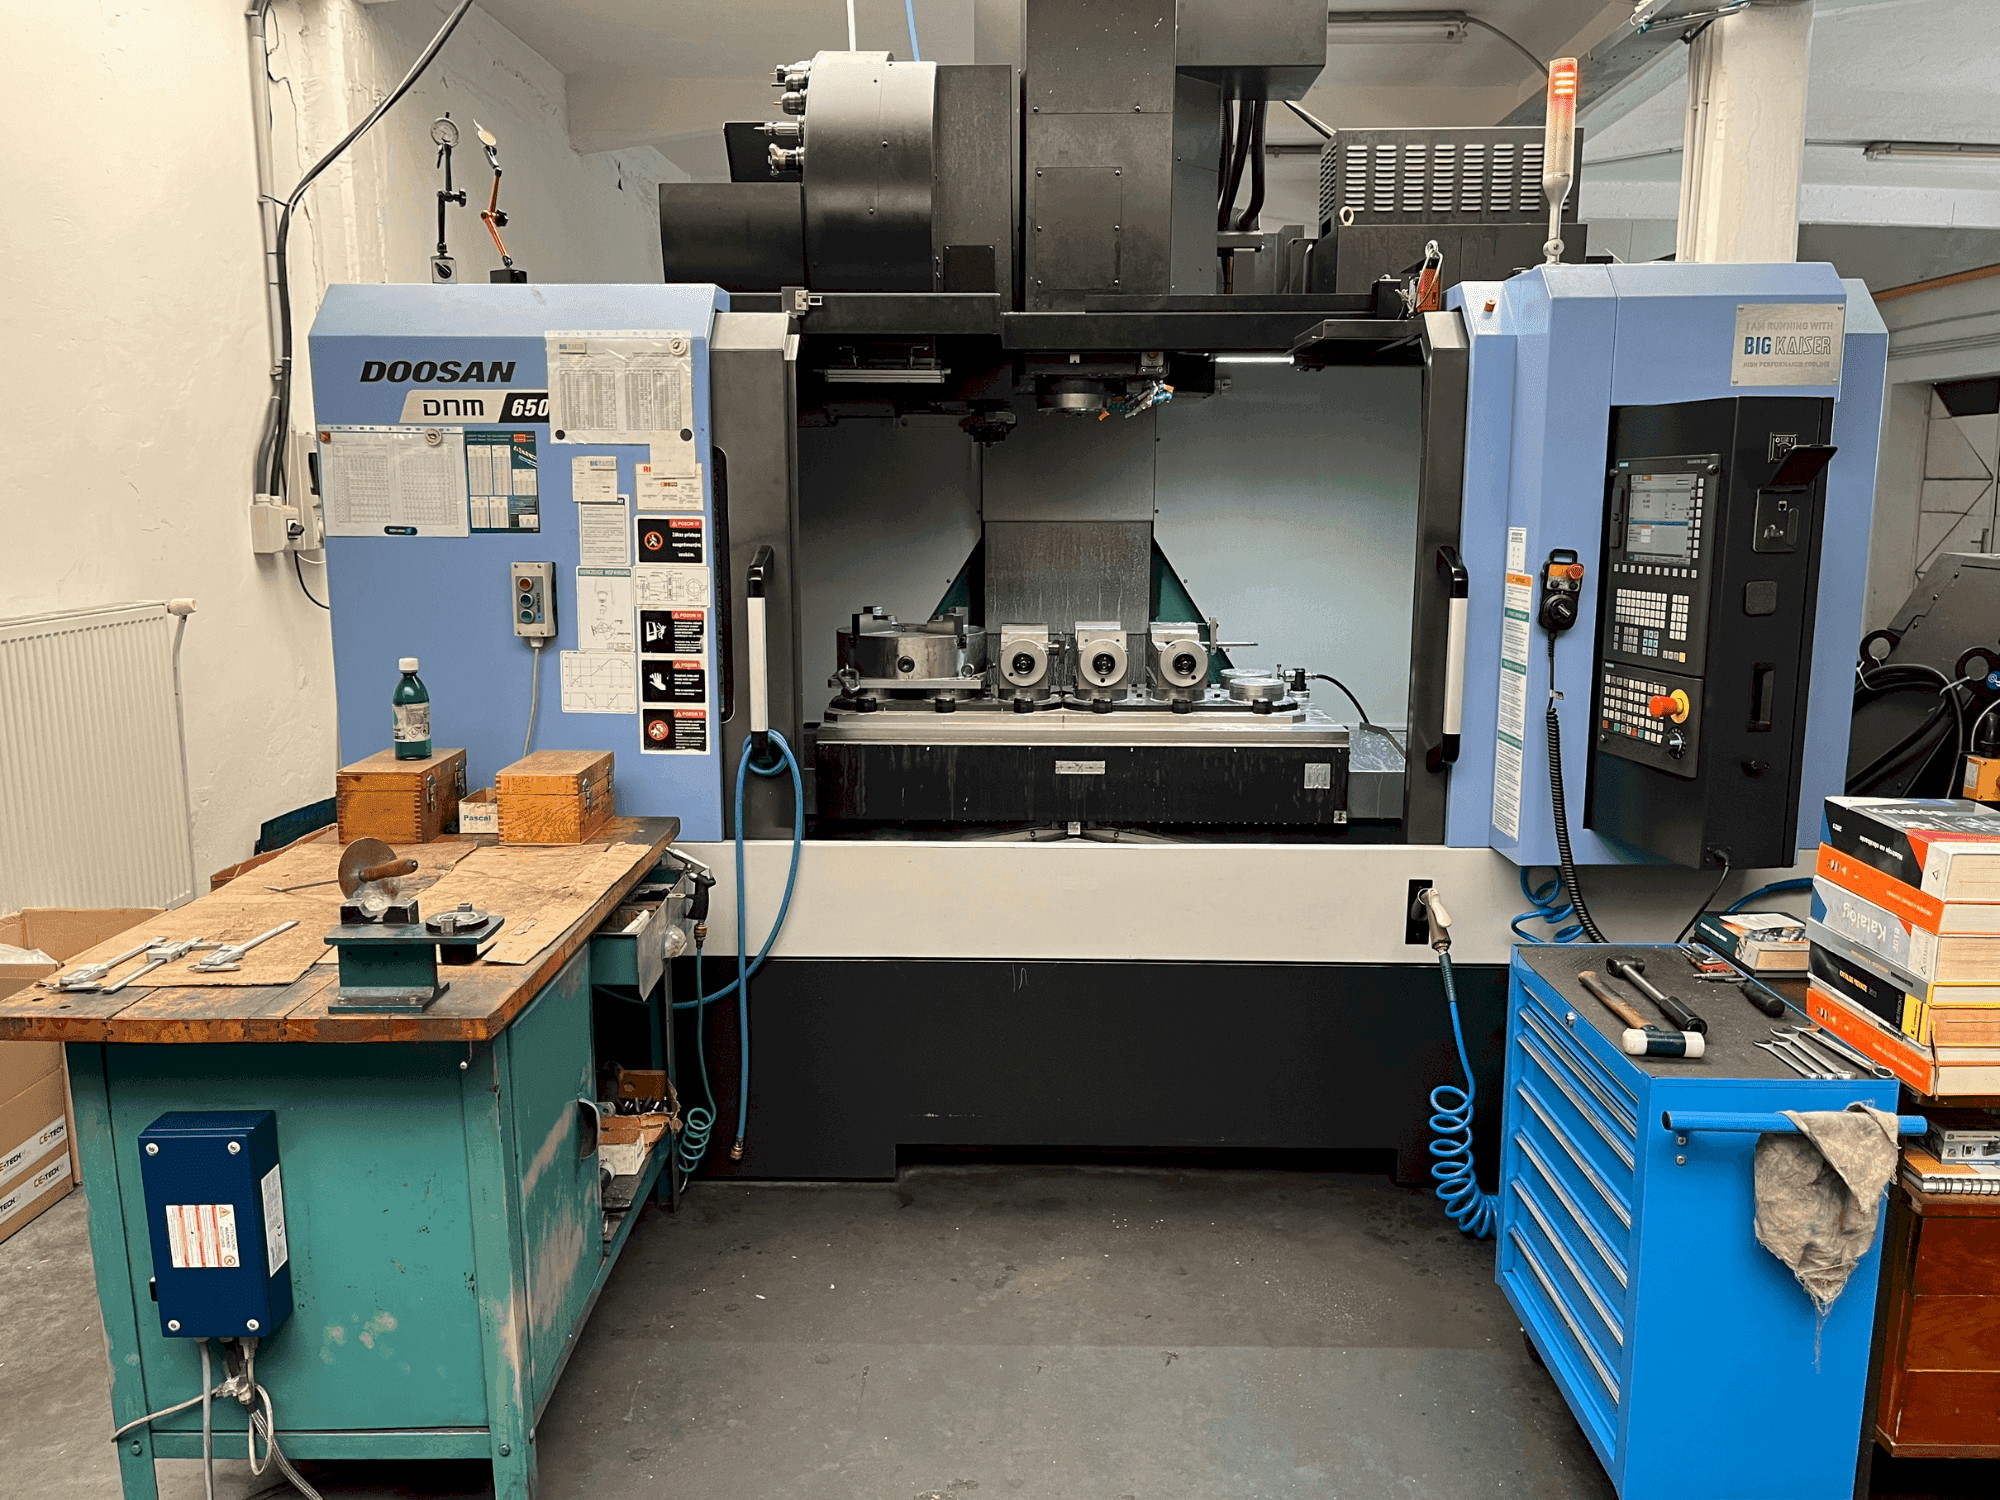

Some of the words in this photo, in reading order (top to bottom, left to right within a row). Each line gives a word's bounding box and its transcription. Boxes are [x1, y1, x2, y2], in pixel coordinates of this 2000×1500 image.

[1751, 322, 1765, 331] AM
[1767, 321, 1808, 331] RUNNING
[1810, 321, 1833, 331] WITH
[1744, 336, 1772, 355] BIG
[1775, 336, 1831, 355] KAISER
[360, 361, 516, 383] DOOSAN
[511, 398, 549, 417] 650
[463, 814, 491, 822] Pascal
[39, 1124, 64, 1145] CE-TECH
[33, 1165, 60, 1188] CE-TECH
